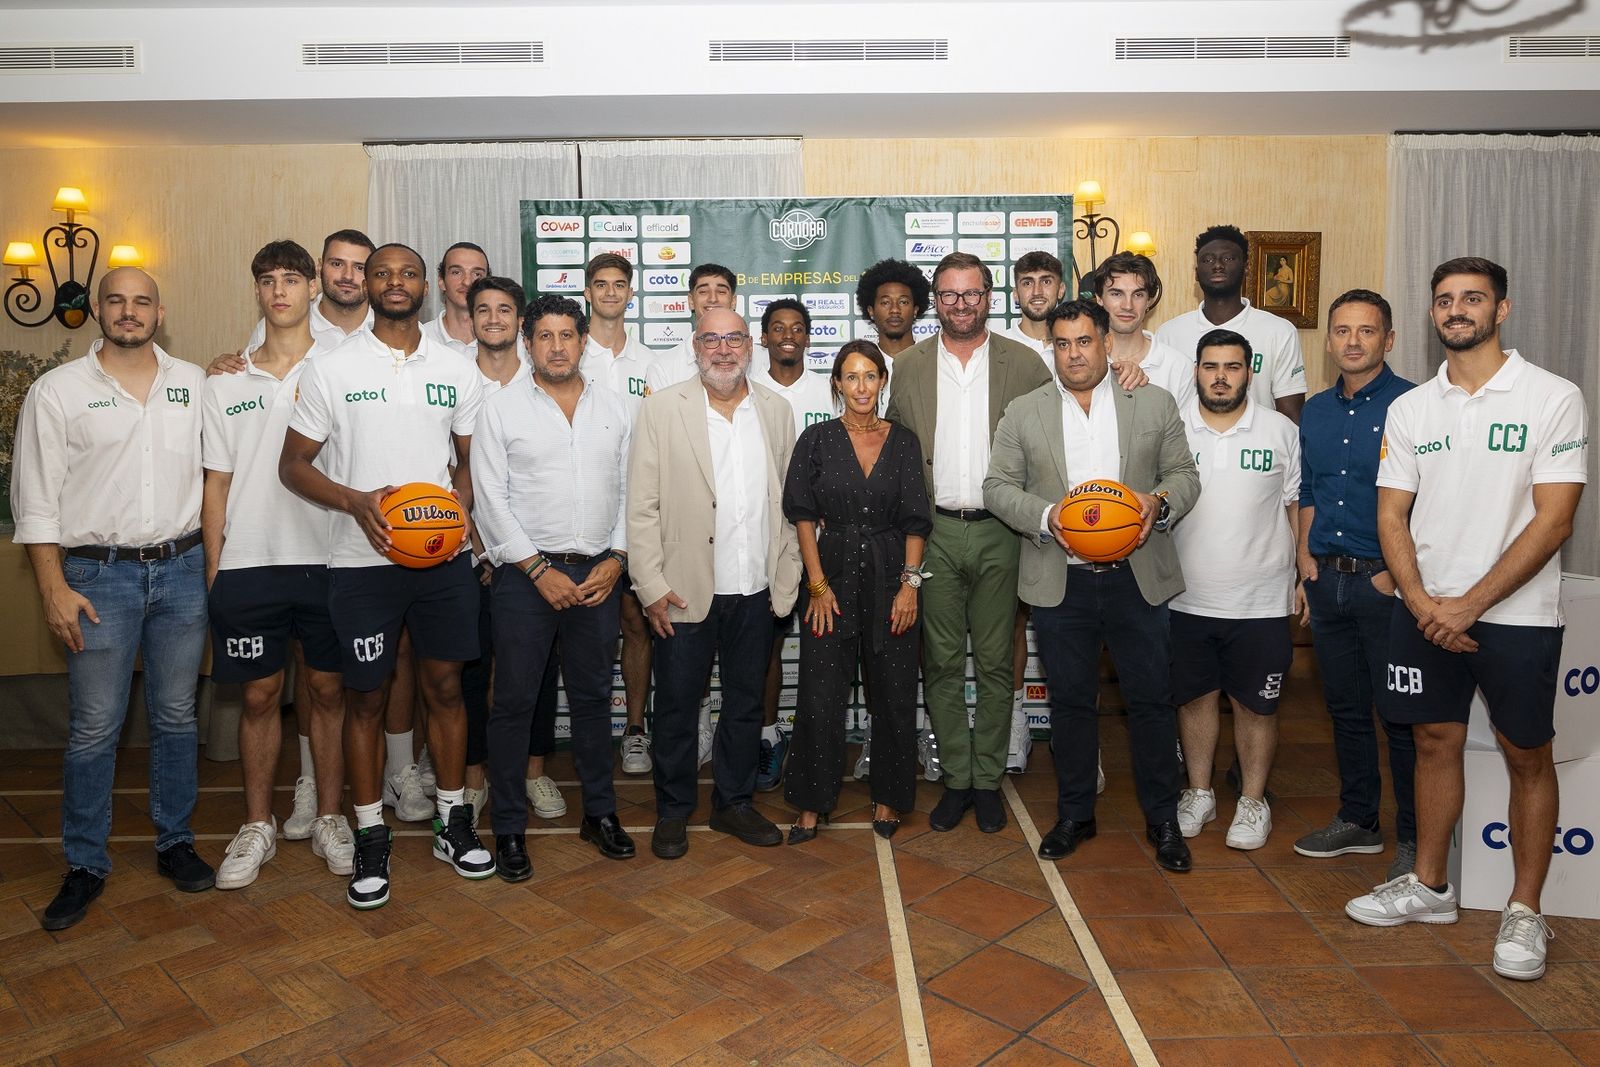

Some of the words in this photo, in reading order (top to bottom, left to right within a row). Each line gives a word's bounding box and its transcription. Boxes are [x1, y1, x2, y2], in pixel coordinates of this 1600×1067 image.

[541, 221, 580, 232] COVAP
[603, 221, 633, 232] Cualix
[649, 273, 678, 285] coto
[748, 276, 759, 285] DE
[761, 271, 842, 286] EMPRESAS
[843, 275, 858, 284] DEL
[663, 300, 685, 311] rahi
[809, 324, 837, 336] coto
[808, 358, 828, 366] TYSA
[166, 387, 190, 405] CCB
[345, 390, 379, 403] coto
[425, 382, 457, 408] CCB
[88, 399, 110, 409] coto
[225, 399, 257, 417] coto
[1240, 448, 1273, 473] CCB
[1069, 482, 1124, 499] Wilson
[402, 504, 460, 523] Wilson
[226, 635, 264, 660] CCB
[353, 632, 384, 662] CCB
[1387, 663, 1423, 696] CCB
